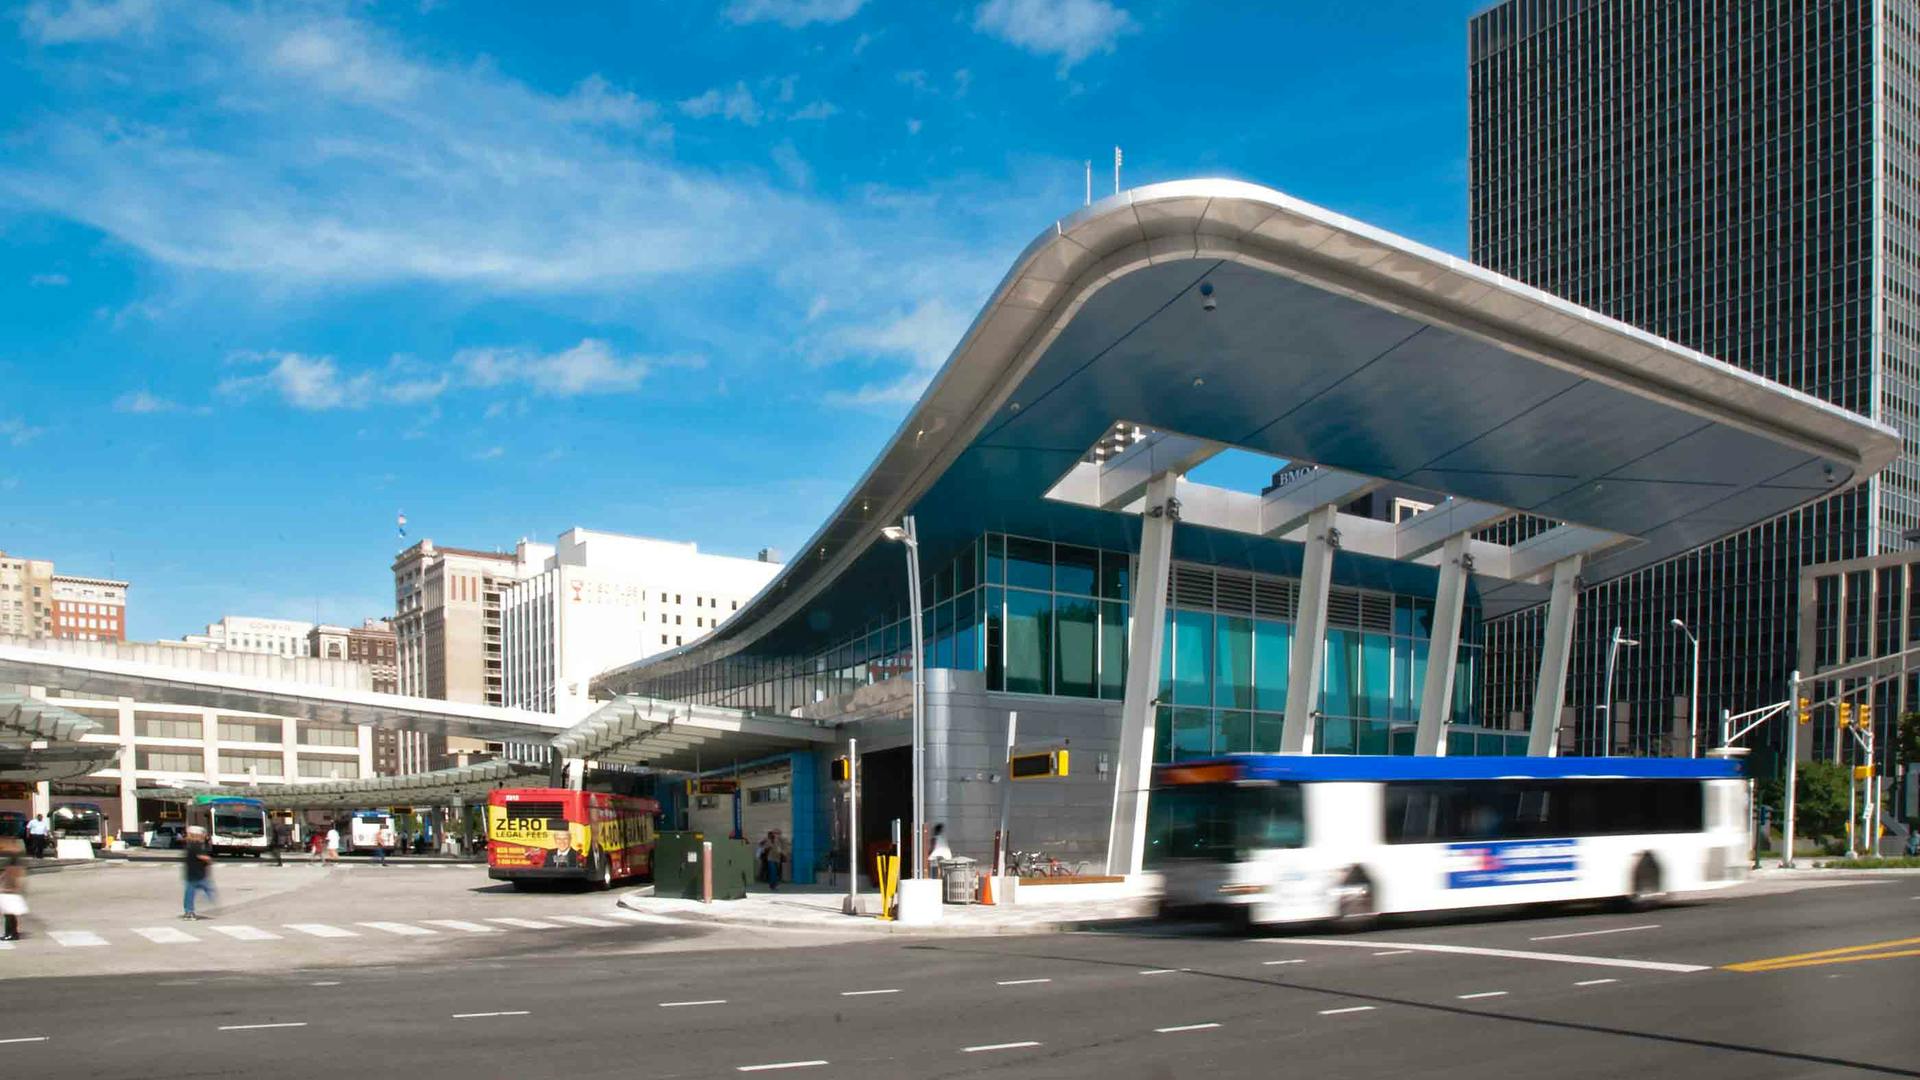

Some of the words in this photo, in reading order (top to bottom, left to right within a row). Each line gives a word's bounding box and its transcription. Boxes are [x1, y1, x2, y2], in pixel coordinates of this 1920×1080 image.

[496, 818, 542, 831] ZERO
[496, 831, 524, 839] LEGAL
[526, 831, 548, 839] FEES
